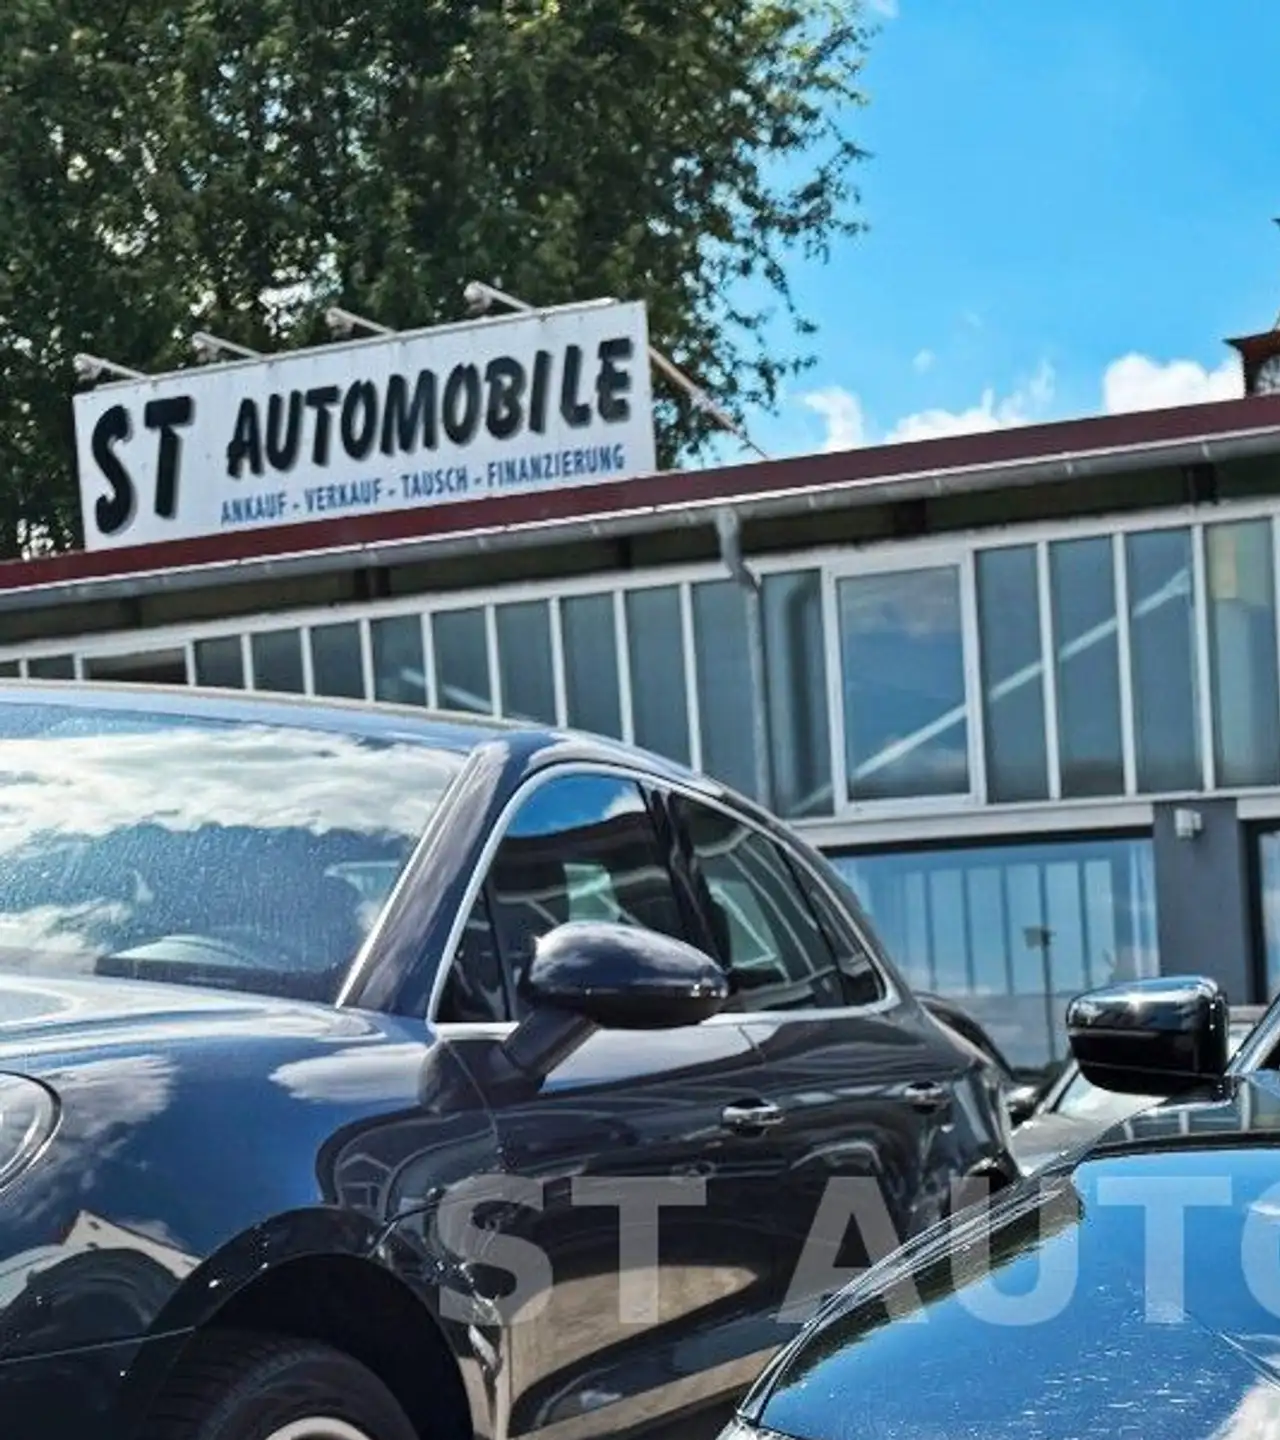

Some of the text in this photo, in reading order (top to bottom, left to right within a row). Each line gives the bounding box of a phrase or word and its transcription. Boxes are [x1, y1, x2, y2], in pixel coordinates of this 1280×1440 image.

[94, 337, 632, 535] ST AUTOMOBILE
[221, 491, 287, 525] ANKAUF
[304, 477, 382, 512] VERKAUF
[401, 466, 468, 500] TAUSCH
[487, 443, 625, 488] FINANZIERUNG
